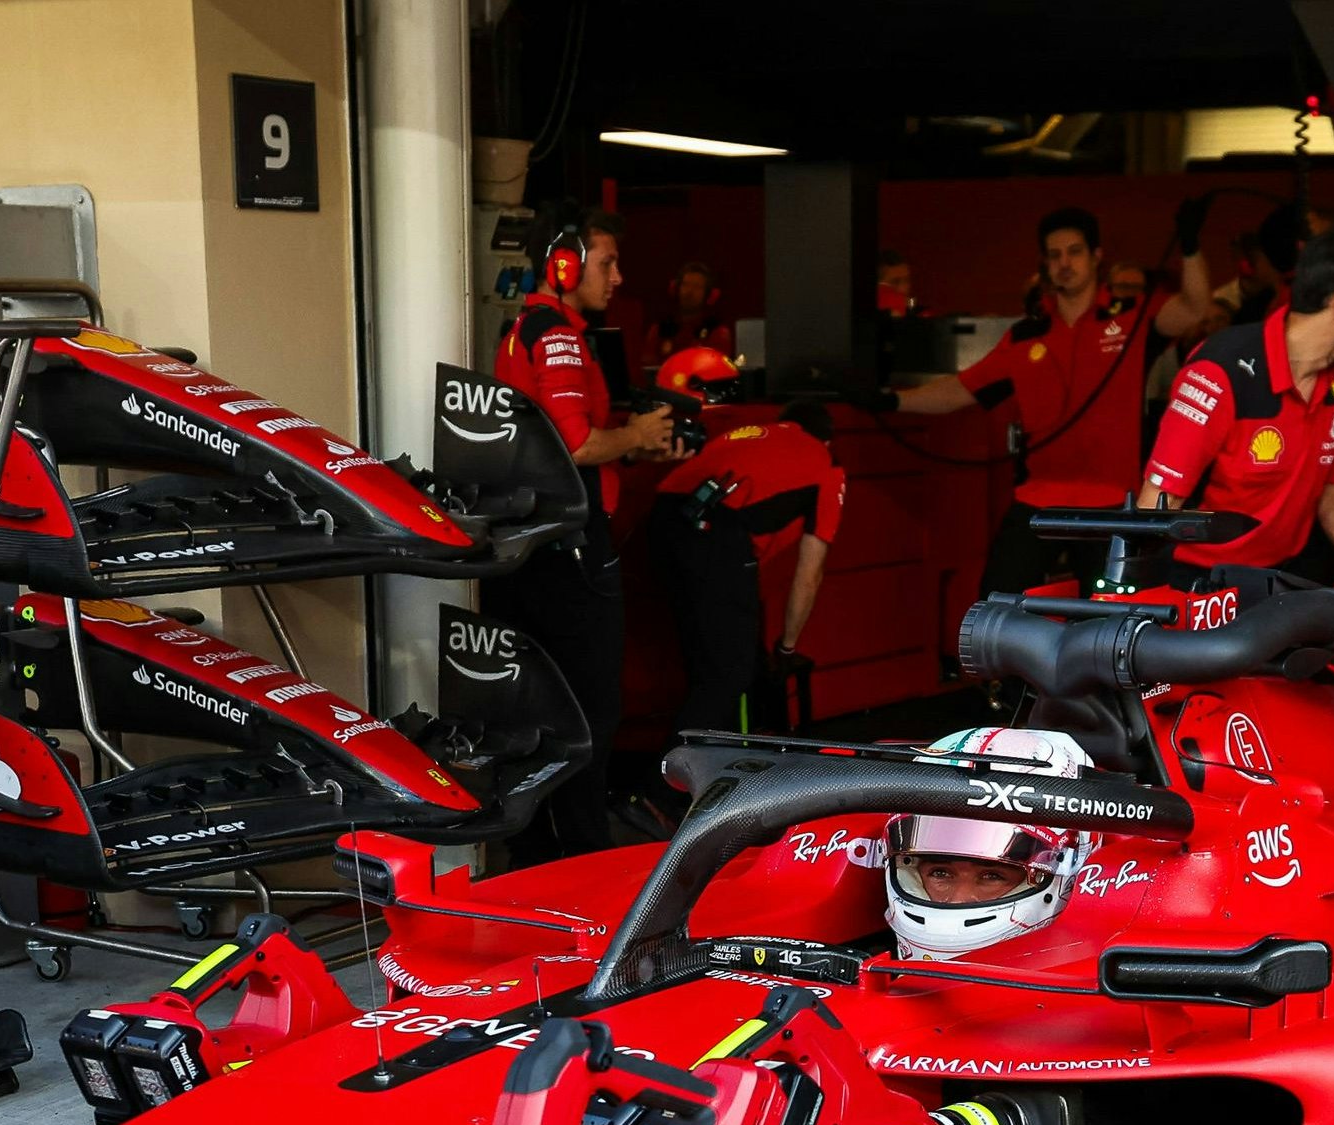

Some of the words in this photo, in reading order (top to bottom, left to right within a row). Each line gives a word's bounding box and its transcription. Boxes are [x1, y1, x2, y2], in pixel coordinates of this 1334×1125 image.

[262, 114, 290, 169] 9
[445, 380, 514, 418] aws
[144, 401, 241, 457] Santander
[102, 540, 235, 565] V-Power
[449, 621, 517, 659] aws
[154, 672, 249, 726] Santander
[967, 779, 1036, 813] DXC
[1043, 794, 1154, 820] TECHNOLOGY
[115, 820, 247, 851] V-Power
[1246, 823, 1293, 864] aws
[1077, 861, 1151, 897] Ray-Ban
[378, 954, 419, 993] HARMAN
[778, 949, 802, 966] 16
[871, 1047, 1005, 1075] HARMAN
[1015, 1057, 1152, 1072] AUTOMOTIVE
